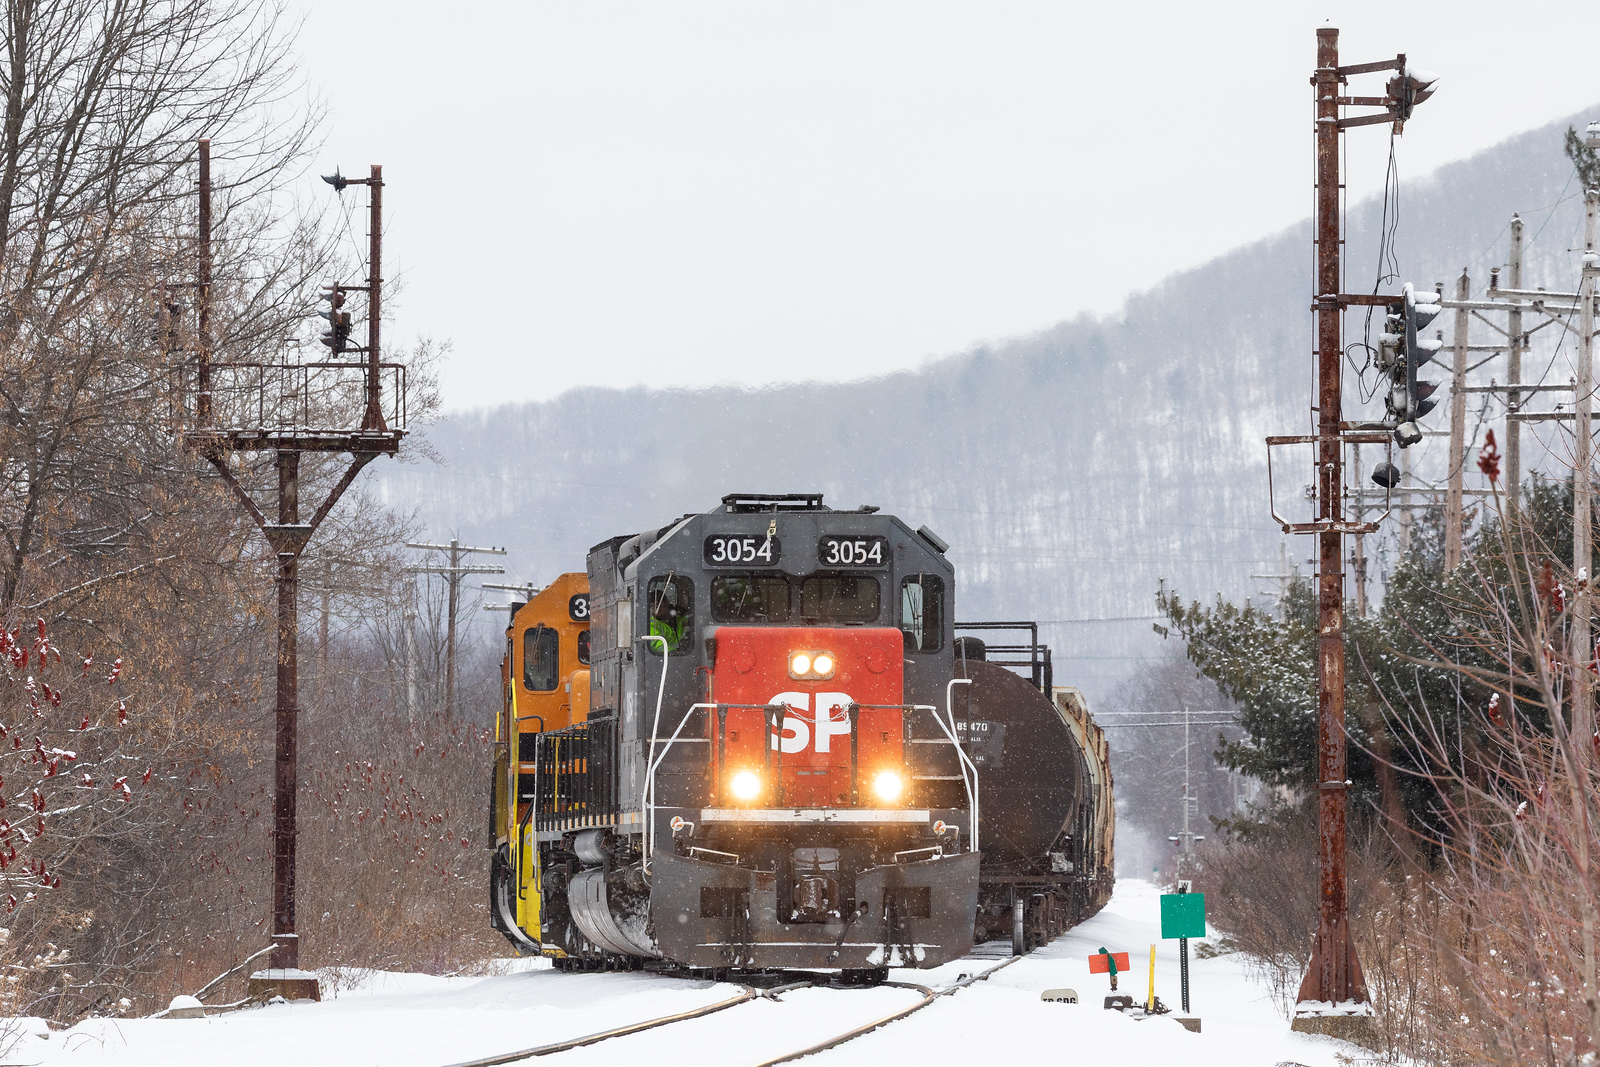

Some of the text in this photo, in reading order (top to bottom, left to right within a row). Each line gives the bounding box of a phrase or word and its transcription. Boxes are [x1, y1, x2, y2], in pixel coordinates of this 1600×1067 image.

[712, 539, 772, 562] 3054
[826, 541, 882, 564] 3054
[574, 598, 590, 618] 3
[768, 691, 854, 754] SP
